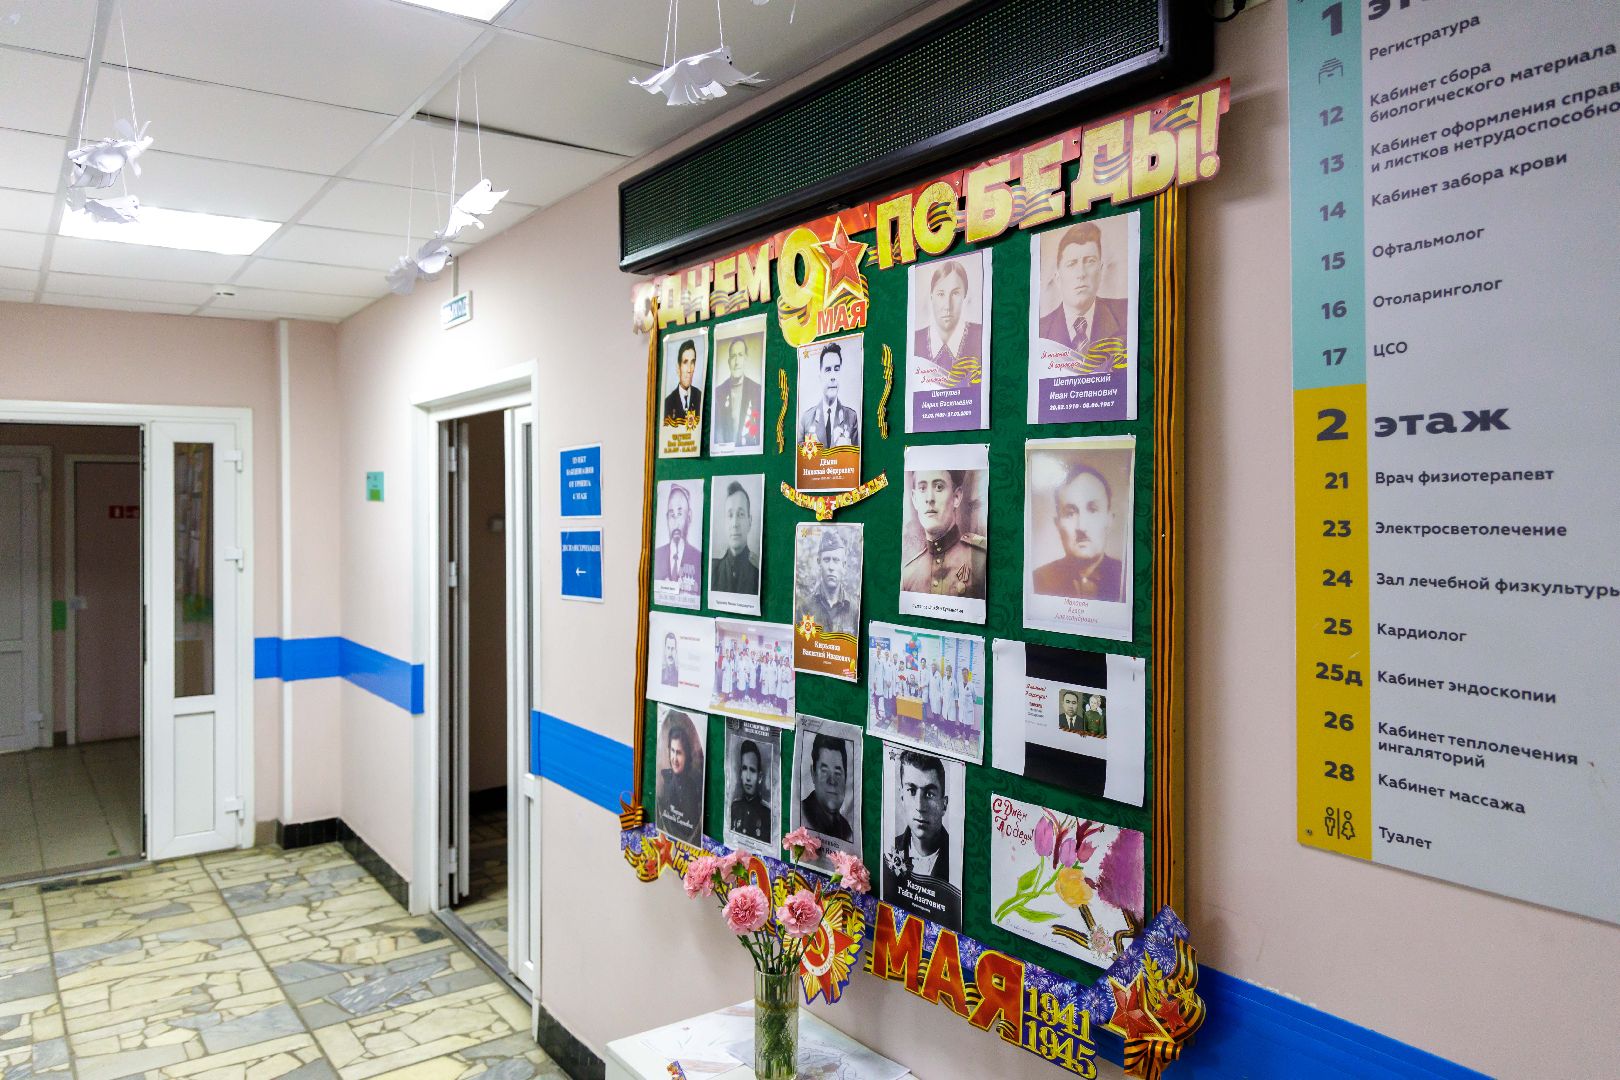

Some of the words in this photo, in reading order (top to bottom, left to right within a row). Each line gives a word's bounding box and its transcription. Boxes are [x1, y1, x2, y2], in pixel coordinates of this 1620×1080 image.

[1320, 2, 1343, 37] 1
[1369, 15, 1481, 60] Регистратура
[1370, 76, 1505, 123] биологического
[1510, 43, 1617, 83] материала
[1370, 79, 1436, 107] Кабинет
[1439, 62, 1491, 86] сбора
[1320, 105, 1344, 126] 12
[1371, 130, 1437, 157] Кабинет
[1441, 99, 1556, 137] оформления
[1561, 81, 1620, 106] справ
[1371, 162, 1380, 173] и
[1383, 145, 1449, 171] листков
[1453, 101, 1620, 153] нетрудоспособно
[876, 87, 1222, 271] ПОБЕДЫ!
[1320, 154, 1345, 175] 13
[1371, 184, 1438, 207] Кабинет
[1441, 168, 1505, 191] забора
[1509, 153, 1568, 176] крови
[1320, 201, 1346, 222] 14
[1372, 227, 1485, 258] Офтальмолог
[1321, 251, 1346, 271] 15
[777, 227, 828, 346] 9
[1372, 279, 1503, 308] Отоларинголог
[817, 300, 867, 335] МАЯ
[1321, 300, 1347, 319] 16
[1322, 347, 1347, 366] 17
[1373, 341, 1408, 357] ЦСО
[1069, 389, 1118, 399] Степанович
[1316, 408, 1349, 442] 2
[1374, 408, 1511, 438] этаж
[1324, 472, 1349, 489] 21
[1375, 471, 1413, 486] Врач
[1418, 469, 1555, 487] физиотерапевт
[1322, 519, 1351, 538] 23
[1375, 521, 1568, 538] Электросветолечение
[1322, 569, 1353, 588] 24
[1376, 572, 1405, 586] Зал
[1408, 576, 1490, 591] лечебной
[1323, 618, 1353, 636] 25
[1377, 623, 1468, 642] Кардиолог
[1315, 662, 1363, 686] 25д
[1377, 671, 1445, 691] Кабинет
[1448, 680, 1557, 704] эндоскопии
[1324, 711, 1354, 731] 26
[1378, 722, 1445, 745] Кабинет
[1448, 734, 1578, 766] теплолечения
[1378, 740, 1485, 768] ингаляторий
[1324, 761, 1355, 781] 28
[1378, 774, 1446, 797] Кабинет
[1449, 788, 1526, 814] массажа
[1378, 827, 1432, 850] Туалет
[870, 900, 1026, 1047] МАЯ
[1023, 987, 1096, 1046] 1941
[1023, 1021, 1097, 1079] 1945
